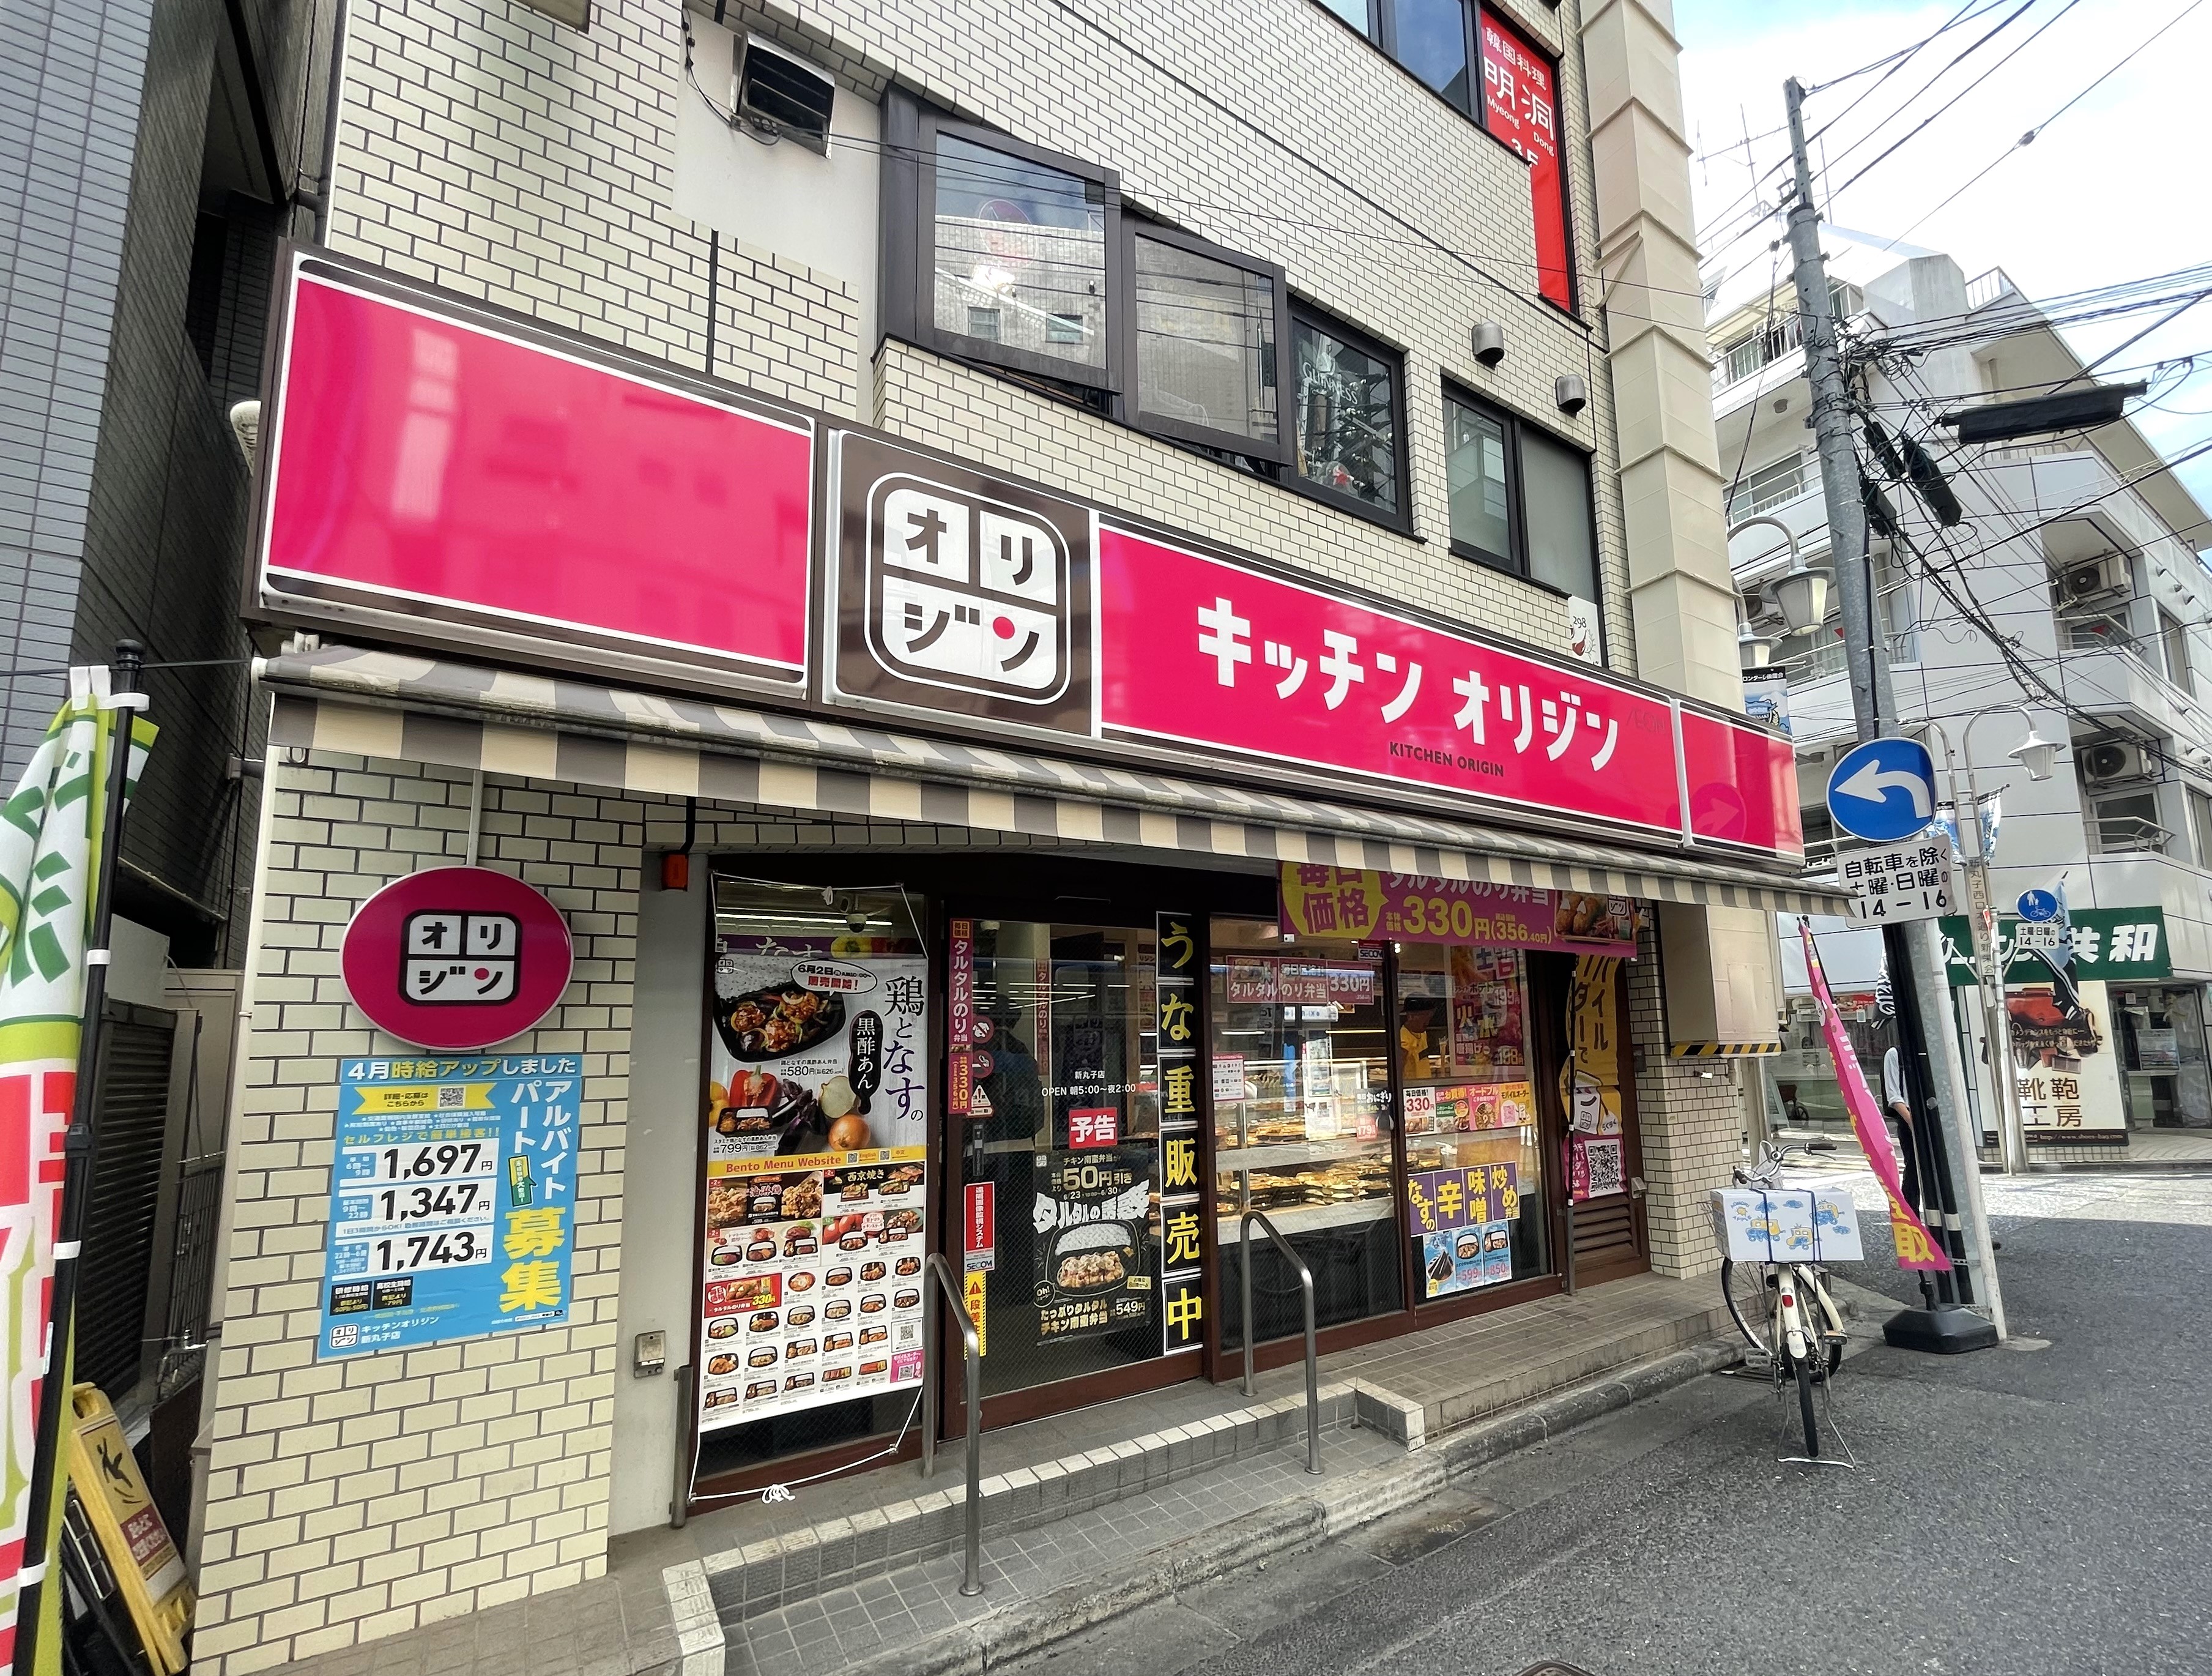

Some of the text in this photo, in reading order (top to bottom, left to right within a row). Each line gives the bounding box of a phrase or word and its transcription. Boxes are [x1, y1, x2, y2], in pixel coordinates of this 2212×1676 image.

[1485, 27, 1546, 91] 韓国料理
[1484, 56, 1554, 141] 明洞
[1487, 95, 1554, 157] Myeong Dong
[1573, 616, 1587, 628] 298
[1197, 597, 1619, 772] キッチン オリジン
[1390, 741, 1504, 778] KITCHEN ORIGIN
[1845, 847, 1948, 879] 自転車を除く
[1302, 888, 1369, 934] 価格
[1403, 895, 1490, 940] 330円
[953, 940, 968, 1042] タルタルのり弁当
[856, 1018, 876, 1090] 黒酢あん
[883, 975, 925, 1121] 鶏となすの
[347, 1059, 576, 1081] 4月時給アップしました
[1074, 1070, 1105, 1079] 新丸子店
[1041, 1087, 1067, 1097] OPEN
[1367, 1090, 1392, 1103] おにぎり
[1469, 1086, 1499, 1097] オードブル
[2017, 1077, 2080, 1101] 靴鞄
[510, 1080, 542, 1153] パート
[1071, 1114, 1116, 1142] 予告
[1160, 920, 1203, 1341] うな重販売中
[2022, 1104, 2083, 1127] 工房
[541, 1080, 573, 1200] アルバイト
[384, 1144, 493, 1180] 1,697円
[726, 1155, 842, 1173] Bento Menu Website
[847, 1169, 885, 1182] 西京焼き
[1063, 1166, 1132, 1191] 50円引き
[380, 1183, 491, 1222] 1,347円
[1437, 1180, 1463, 1220] 辛
[1468, 1169, 1488, 1224] 味噌
[377, 1231, 487, 1272] 1,743円
[499, 1207, 566, 1313] 募集
[967, 1259, 993, 1270] SECOM
[1036, 1286, 1050, 1297] Oh!
[1041, 1298, 1108, 1321] たっぷりタルタル
[1116, 1301, 1146, 1316] 549円
[361, 1316, 439, 1333] キッチンオリジン
